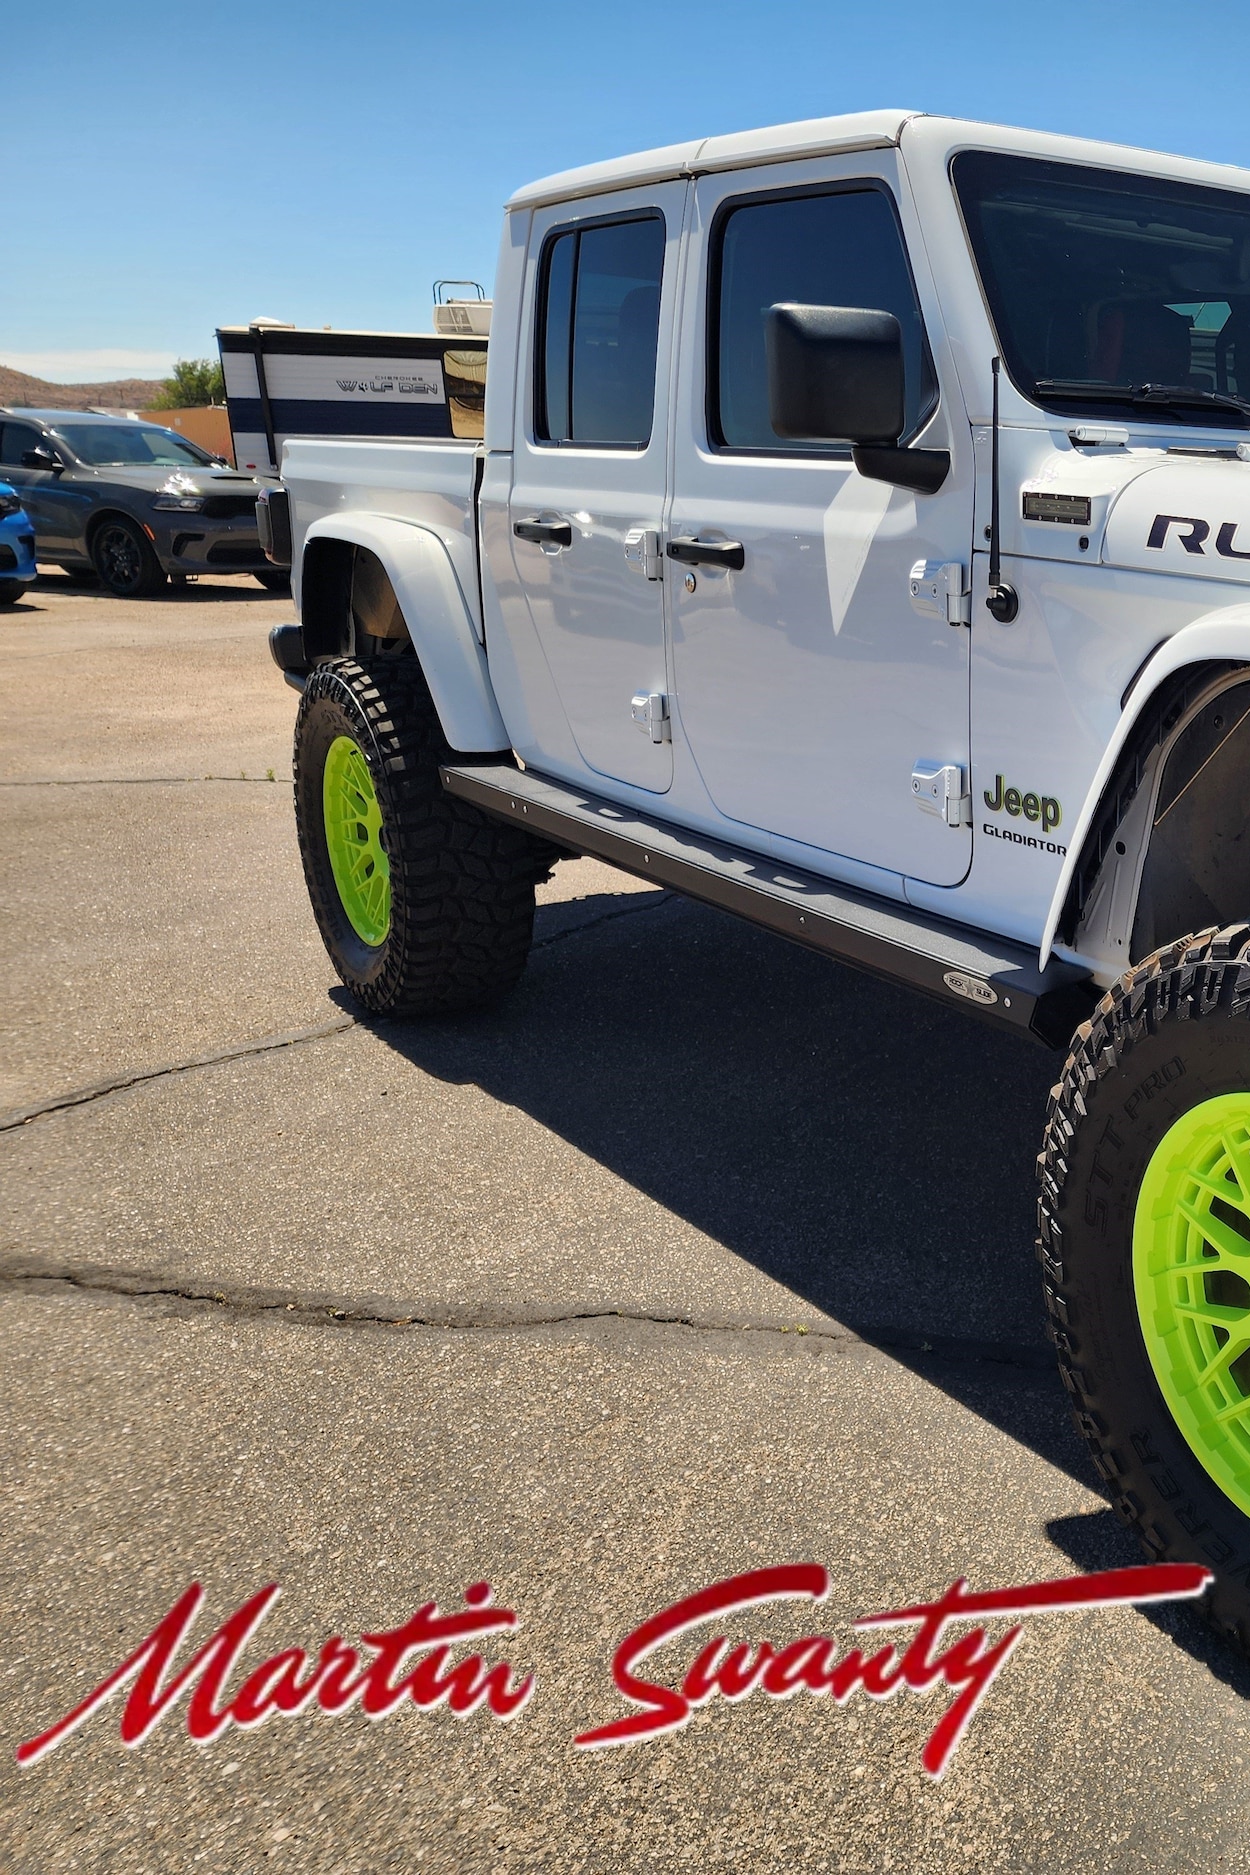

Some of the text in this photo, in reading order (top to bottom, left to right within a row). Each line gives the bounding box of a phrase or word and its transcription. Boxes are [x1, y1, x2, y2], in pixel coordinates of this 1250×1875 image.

[399, 382, 437, 394] DEN
[983, 773, 1062, 835] Jeep
[983, 823, 1067, 857] GLADIATOR
[1124, 1054, 1188, 1122] PRO
